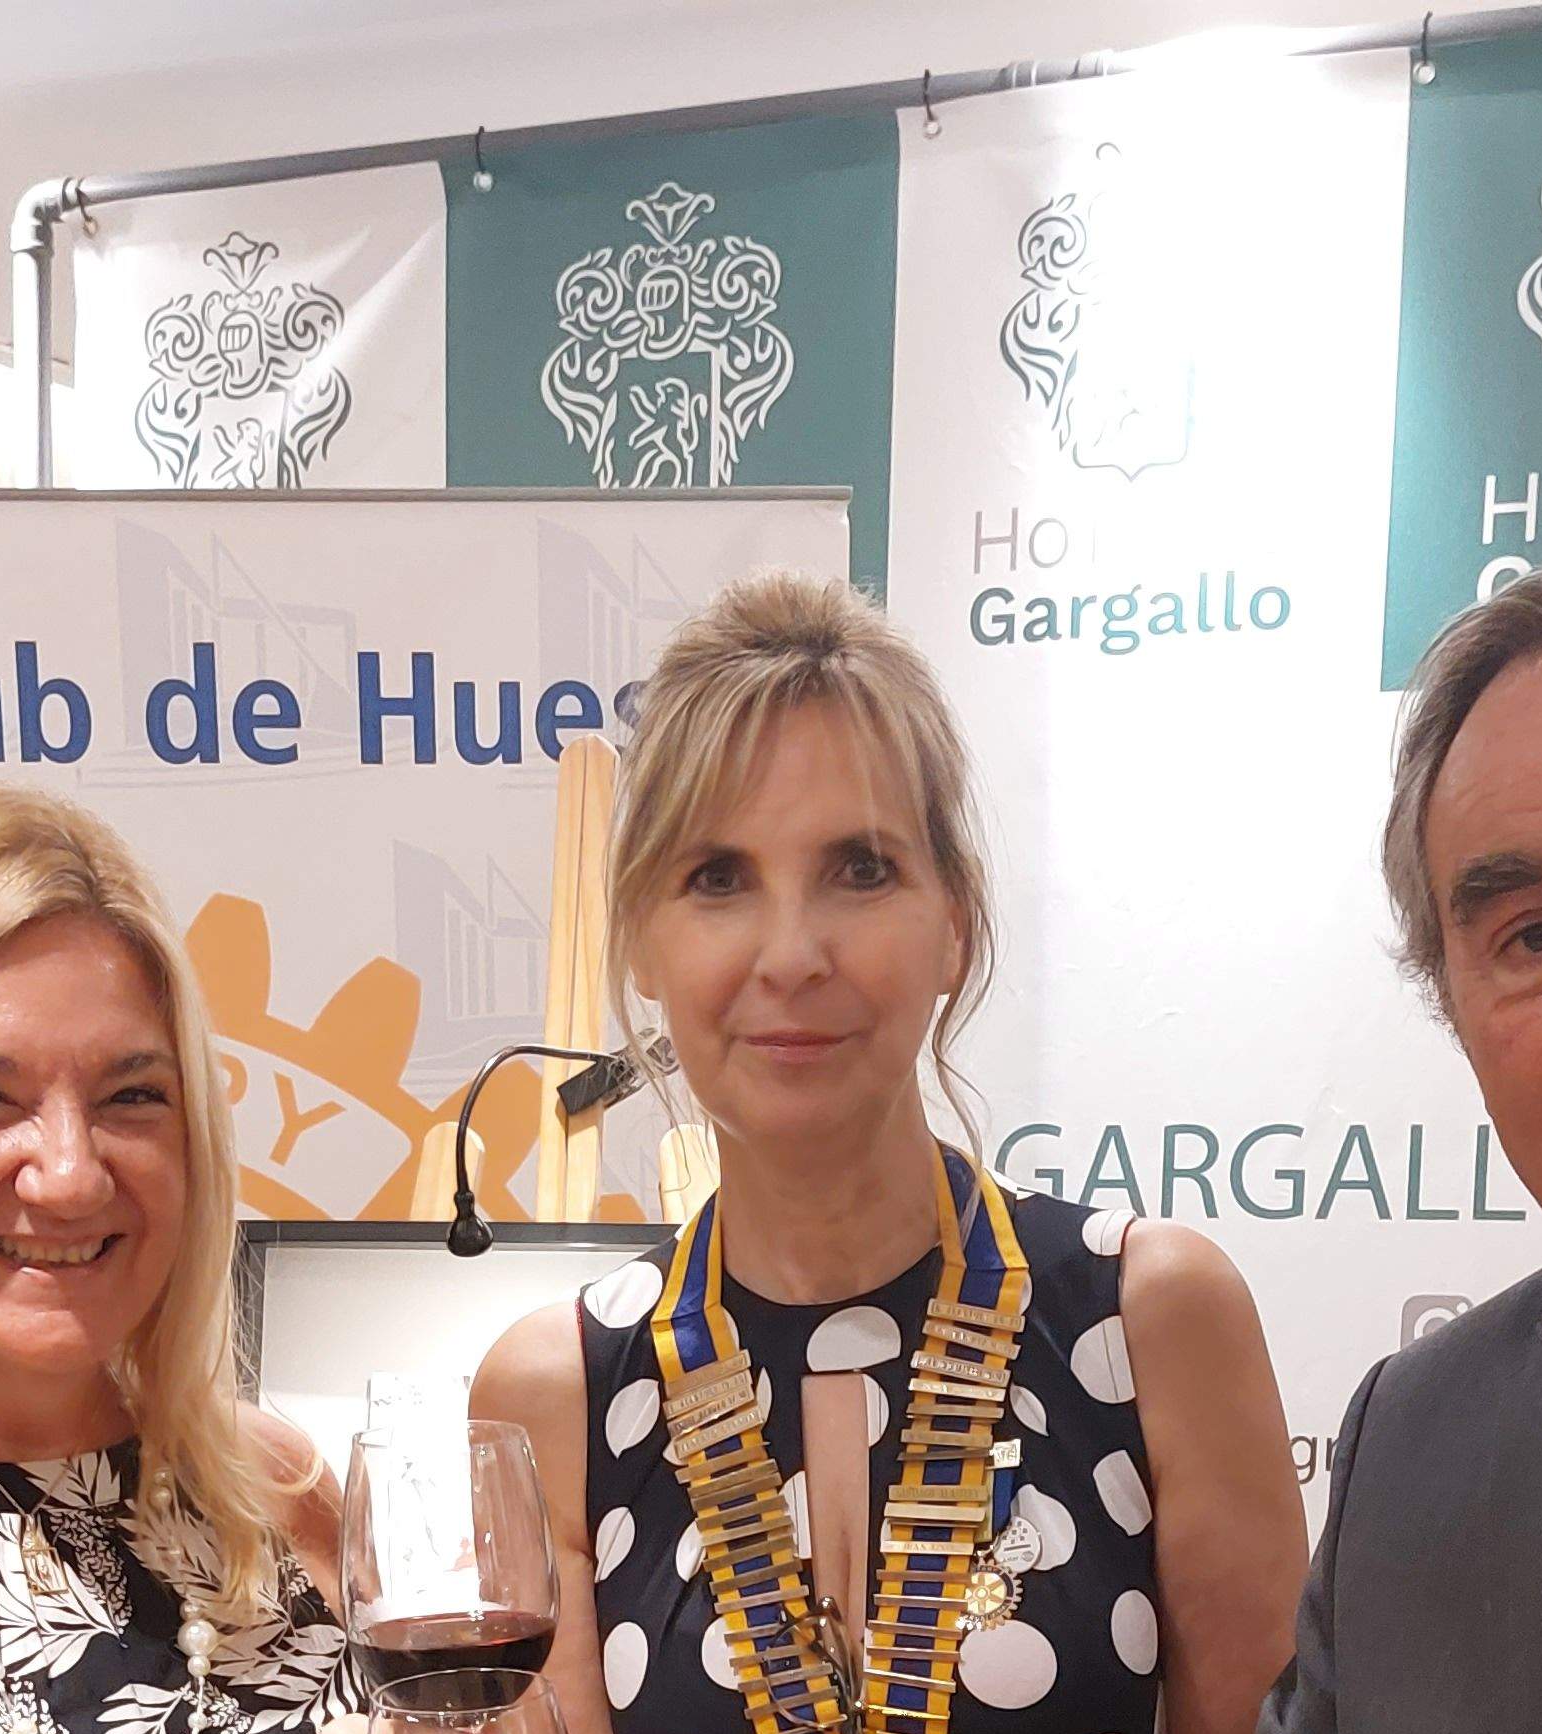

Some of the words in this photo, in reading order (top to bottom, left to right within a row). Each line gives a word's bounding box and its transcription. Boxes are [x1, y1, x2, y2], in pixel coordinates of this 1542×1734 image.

[968, 572, 1292, 657] Gargallo
[146, 644, 302, 765] de
[357, 650, 646, 765] Hue
[994, 1122, 1527, 1222] GARGALL
